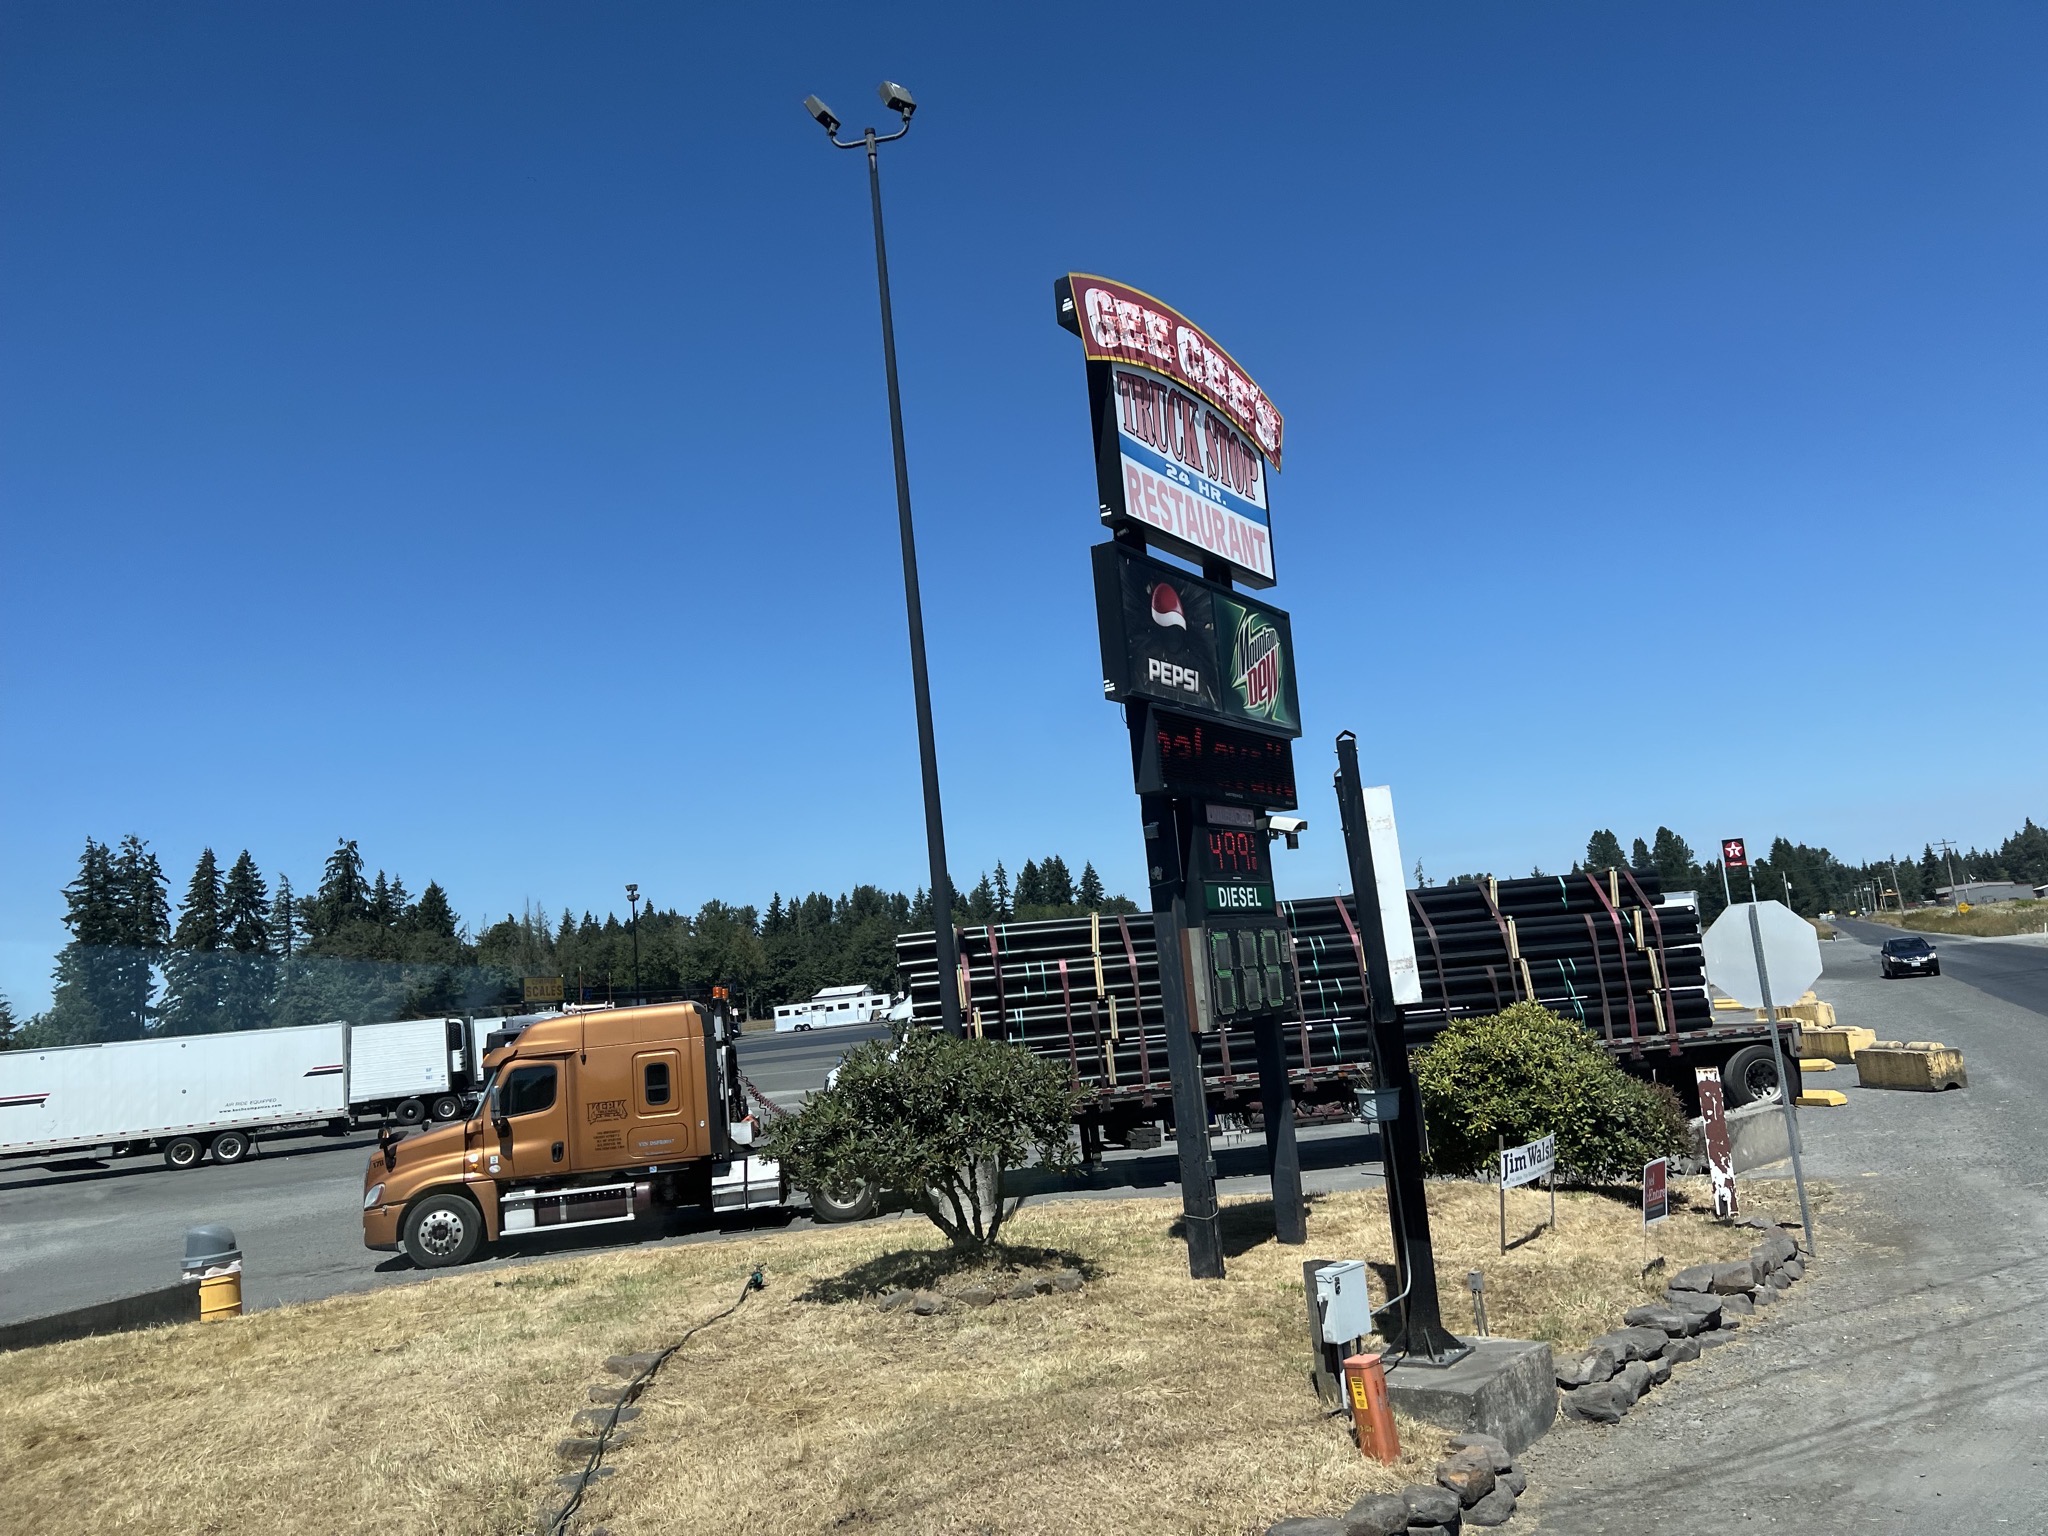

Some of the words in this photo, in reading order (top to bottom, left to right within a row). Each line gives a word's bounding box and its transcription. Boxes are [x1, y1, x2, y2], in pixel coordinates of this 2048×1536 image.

[1085, 288, 1176, 363] GEE
[1116, 371, 1204, 473] TRUCK
[1204, 409, 1259, 500] STOP
[1165, 463, 1191, 487] 24
[1198, 475, 1227, 505] HR.
[1126, 463, 1267, 573] RESTAURANT
[1148, 658, 1199, 693] PEPSI
[1217, 886, 1262, 908] DIESEL
[525, 985, 563, 998] SCALES
[1503, 1152, 1527, 1182] Jim
[1527, 1138, 1554, 1167] Walsh
